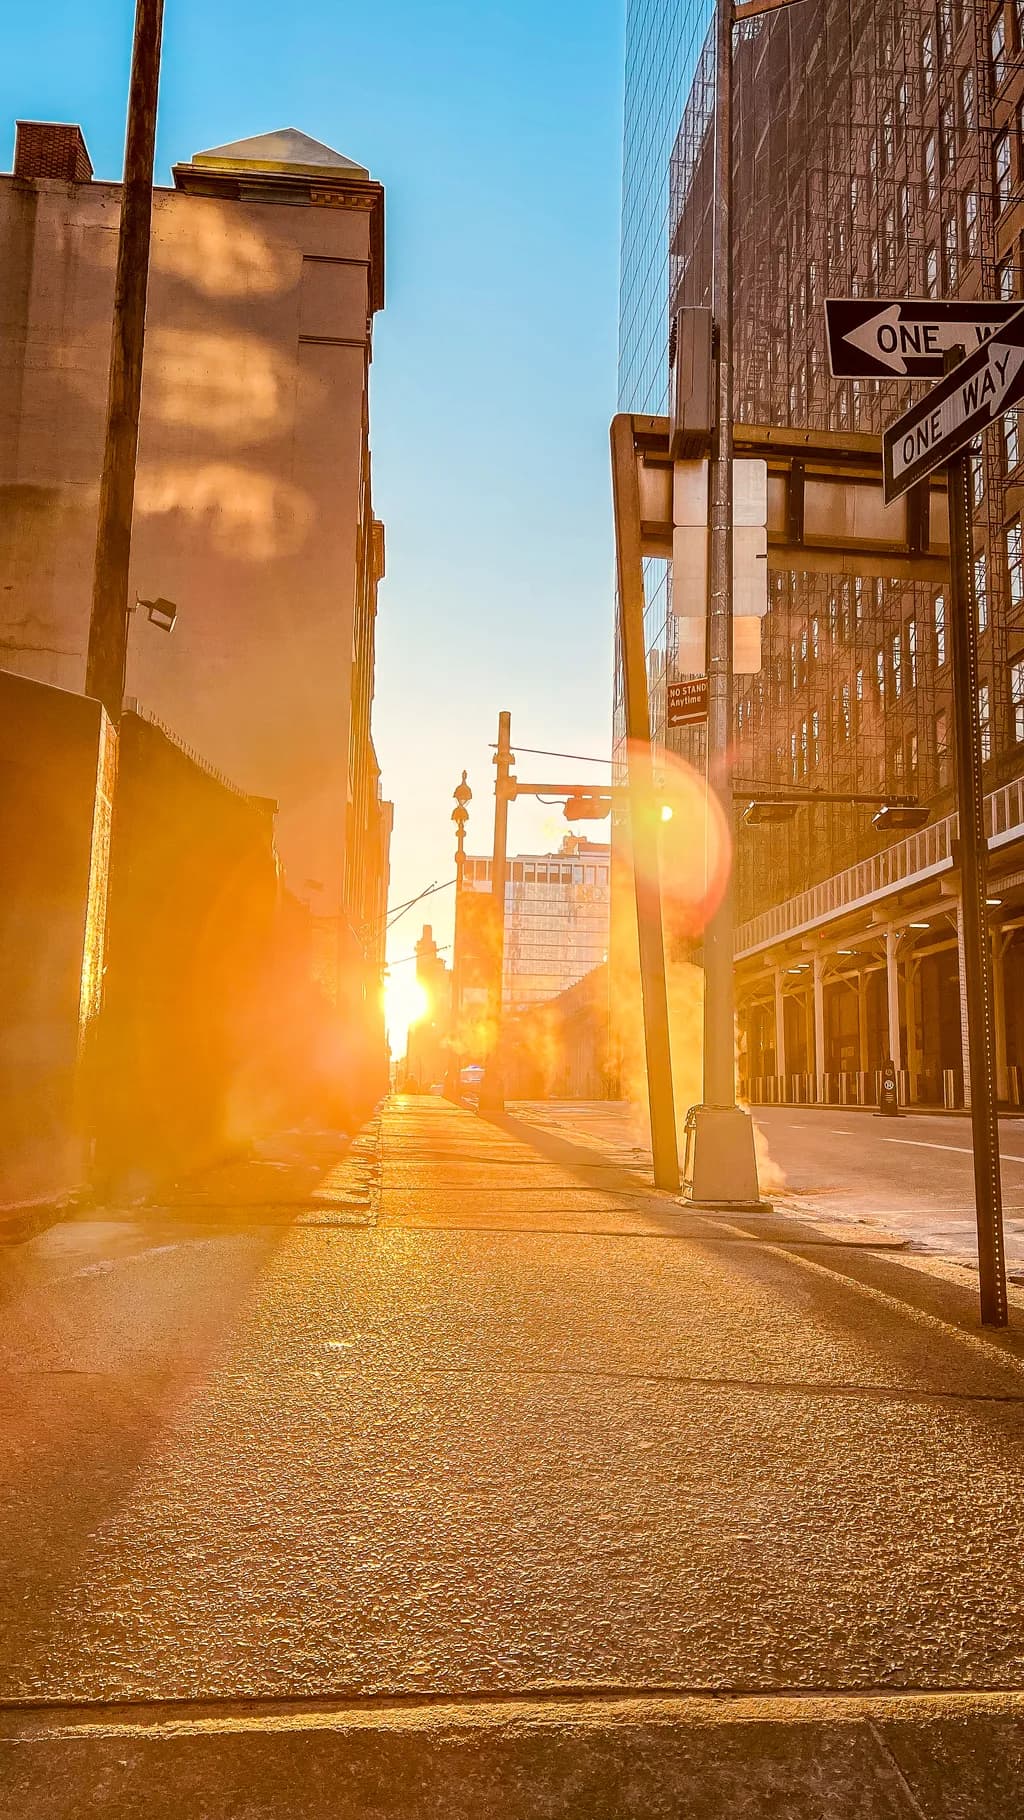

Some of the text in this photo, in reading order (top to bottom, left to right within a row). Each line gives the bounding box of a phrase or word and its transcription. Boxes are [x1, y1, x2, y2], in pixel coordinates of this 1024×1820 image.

[876, 325, 942, 354] ONE
[902, 349, 1011, 465] ONE WAY
[670, 683, 707, 698] NO STAND
[670, 695, 702, 708] Anytime
